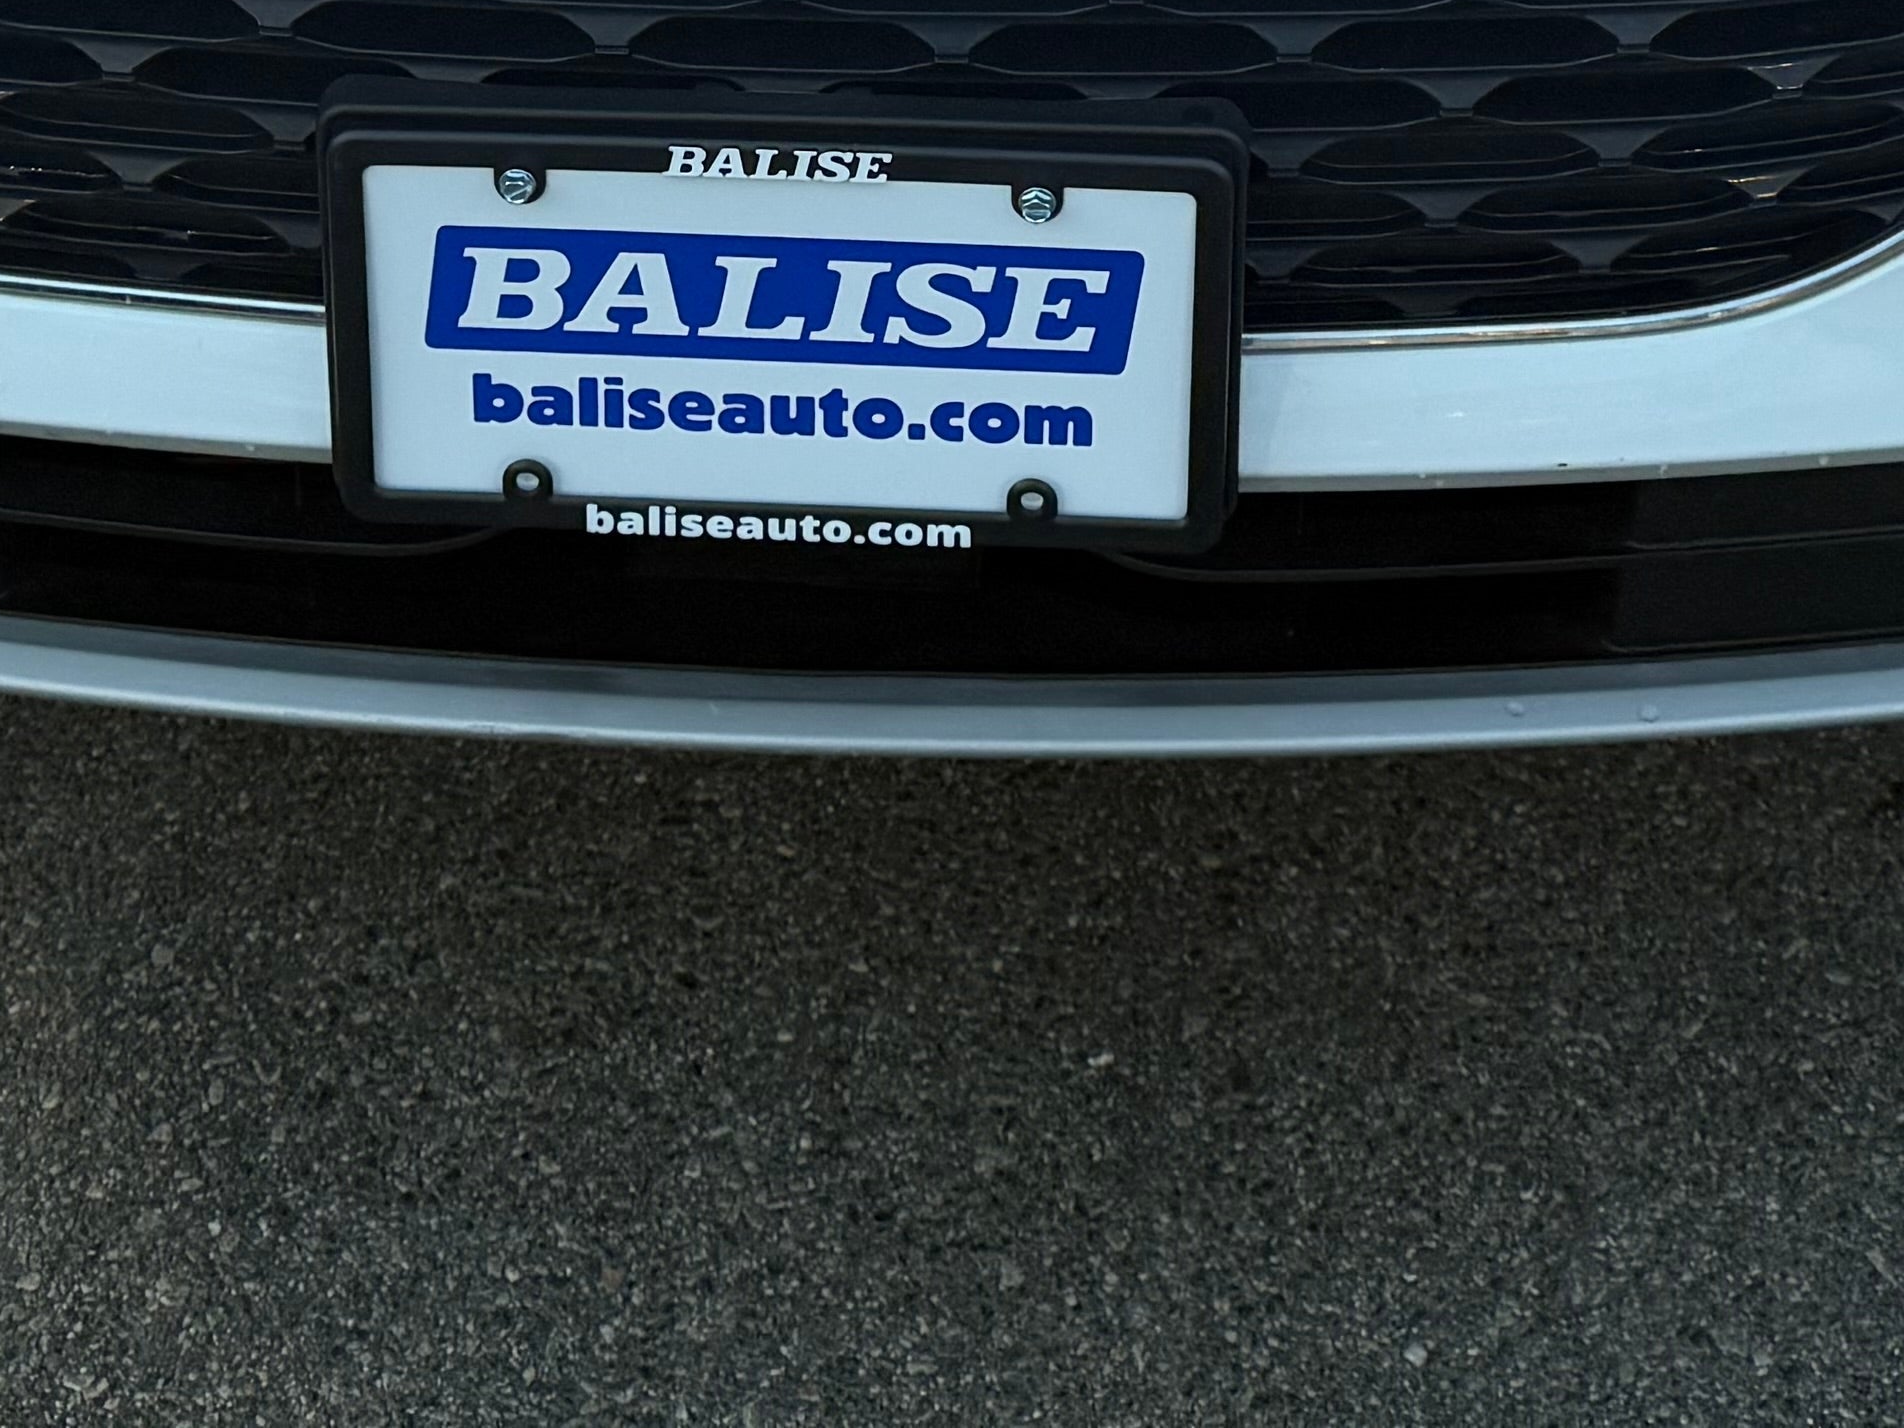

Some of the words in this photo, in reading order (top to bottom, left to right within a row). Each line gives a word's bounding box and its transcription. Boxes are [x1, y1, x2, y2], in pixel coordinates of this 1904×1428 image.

[664, 145, 893, 184] BALISE
[457, 246, 1110, 352] BALISE
[472, 373, 1094, 447] baliseauto.com
[585, 504, 972, 548] baliseauto.com
